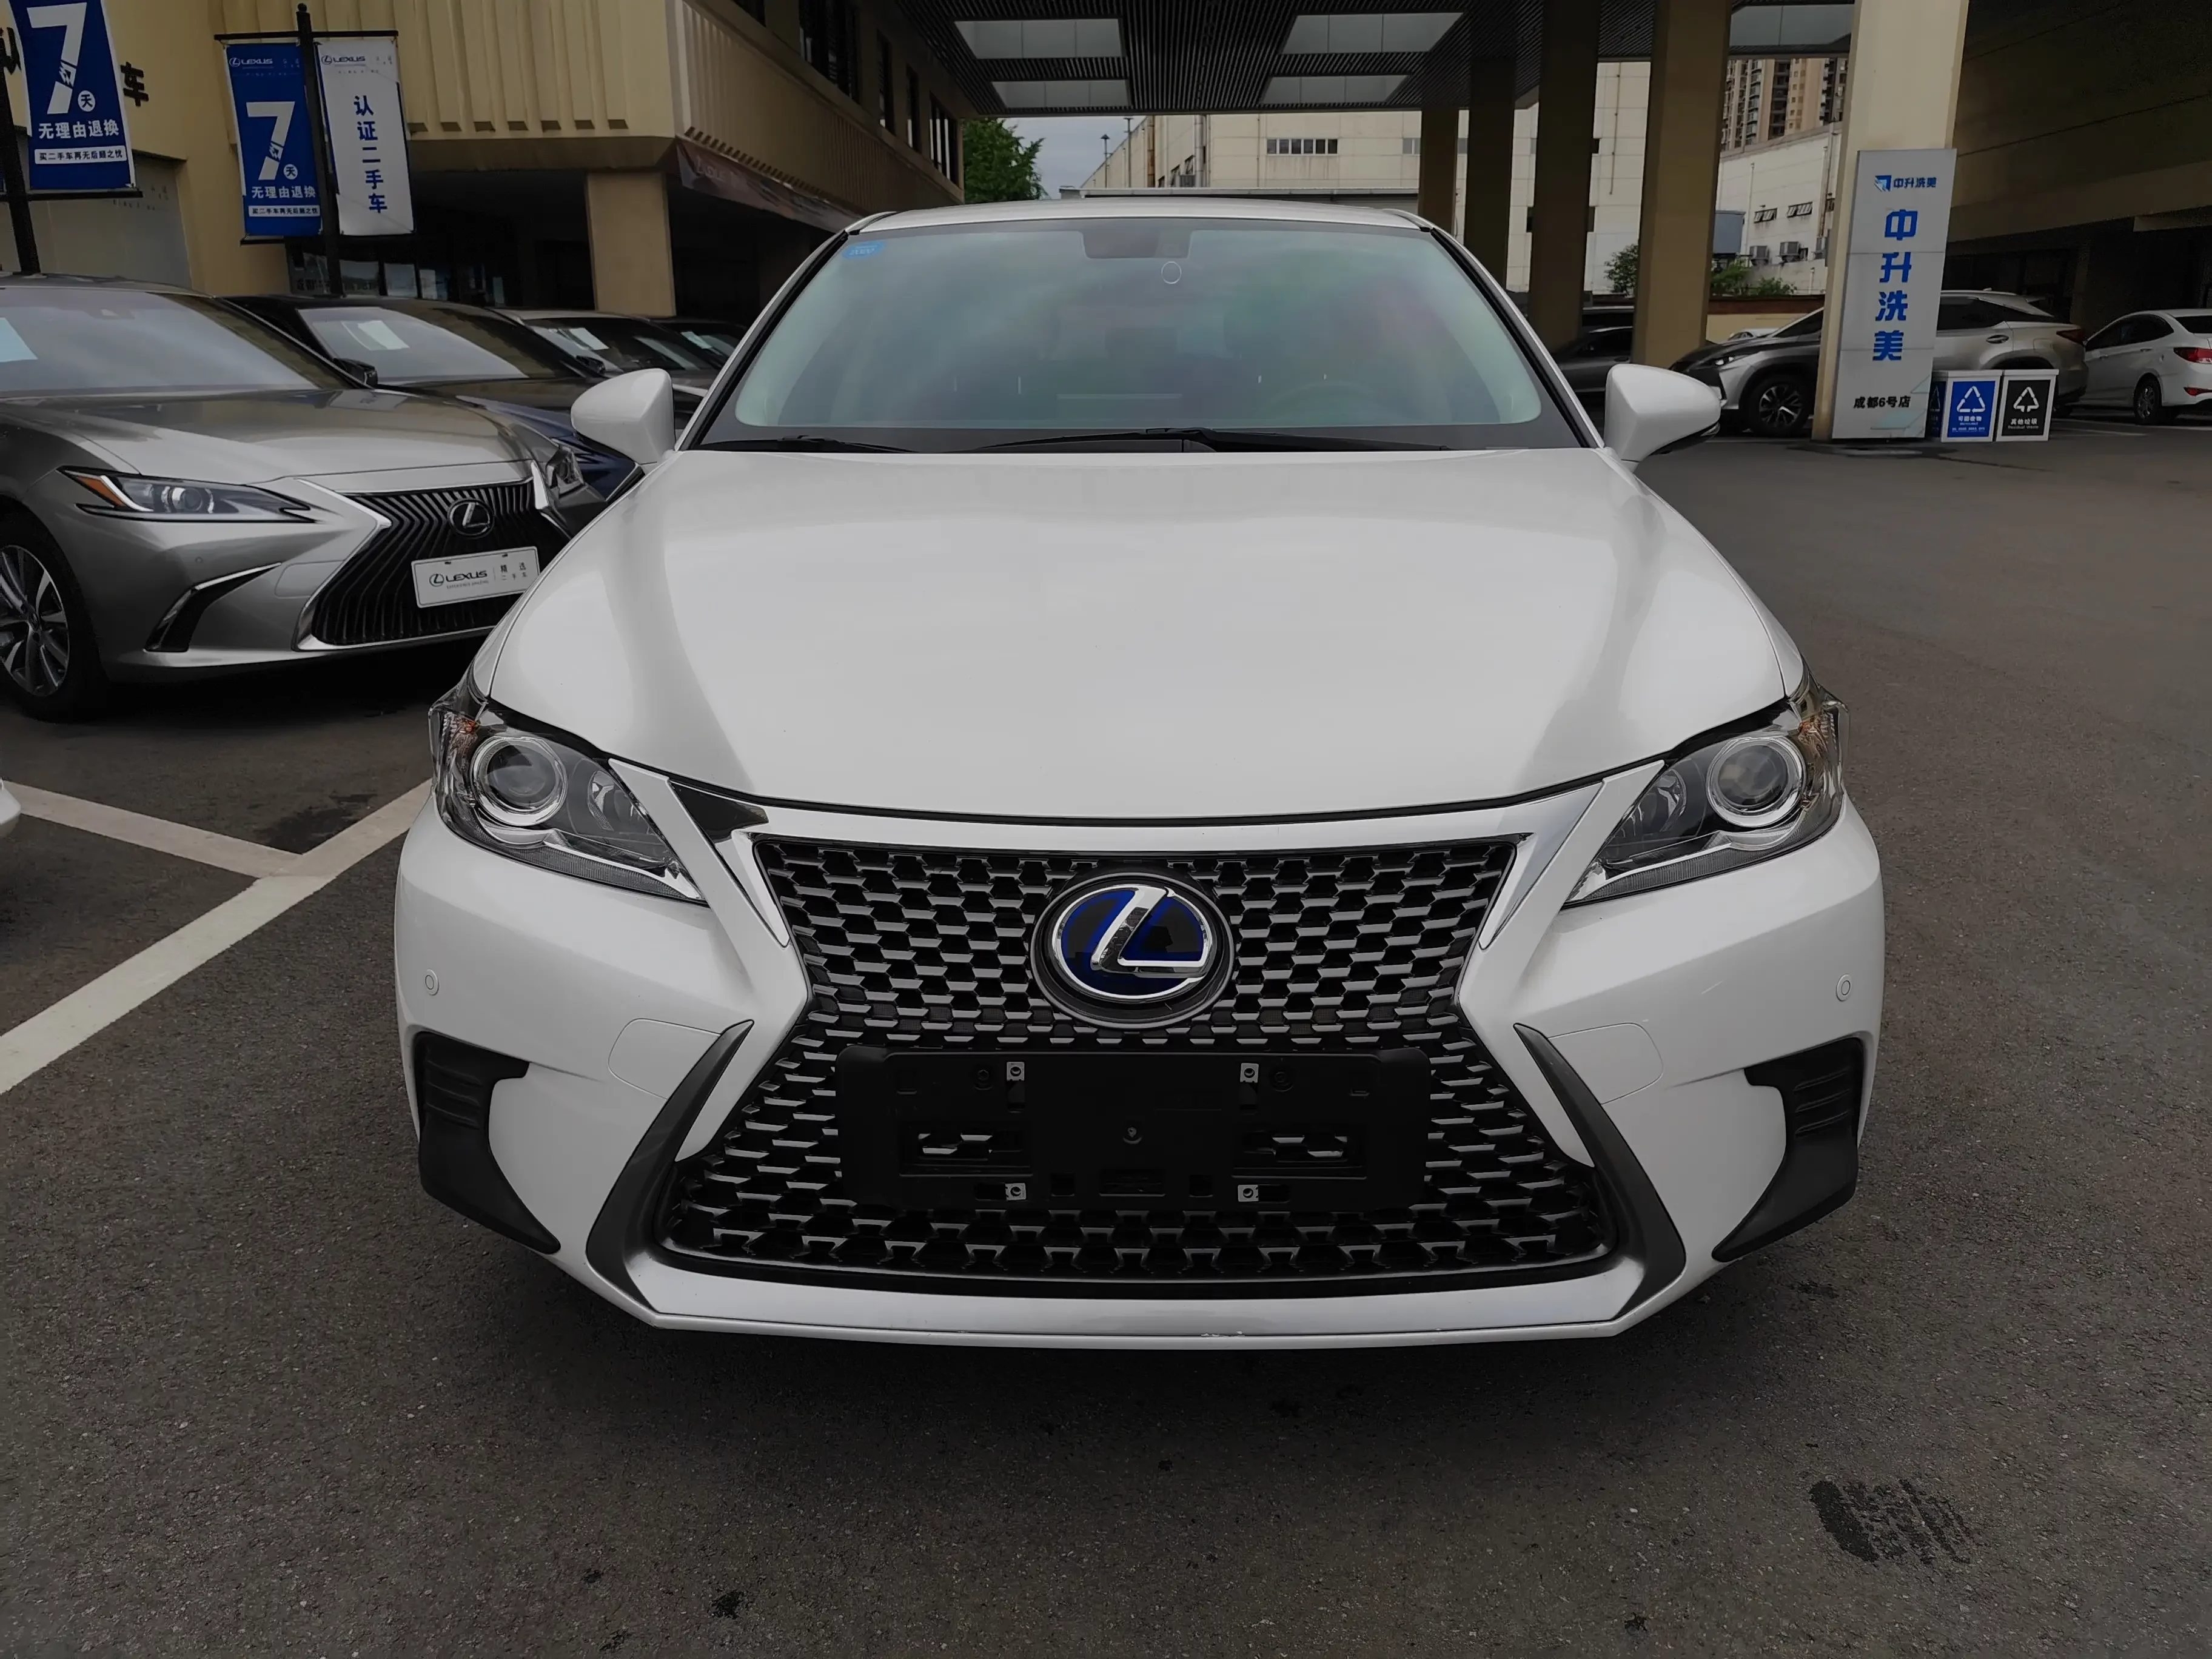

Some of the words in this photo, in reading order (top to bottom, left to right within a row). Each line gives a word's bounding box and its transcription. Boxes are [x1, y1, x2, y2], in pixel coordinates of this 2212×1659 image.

[27, 2, 87, 114] 7
[121, 61, 149, 107] 车
[81, 93, 93, 108] 天
[38, 119, 119, 139] 无理由退换
[246, 101, 295, 180] 7
[354, 95, 387, 213] 认证二手车
[286, 166, 296, 177] 天
[1893, 176, 1937, 189] 中升洗美
[252, 185, 316, 199] 无理由退换
[1872, 209, 1918, 361] 中升洗美
[1853, 395, 1911, 409] 成都6号店
[446, 570, 488, 582] LEXUS
